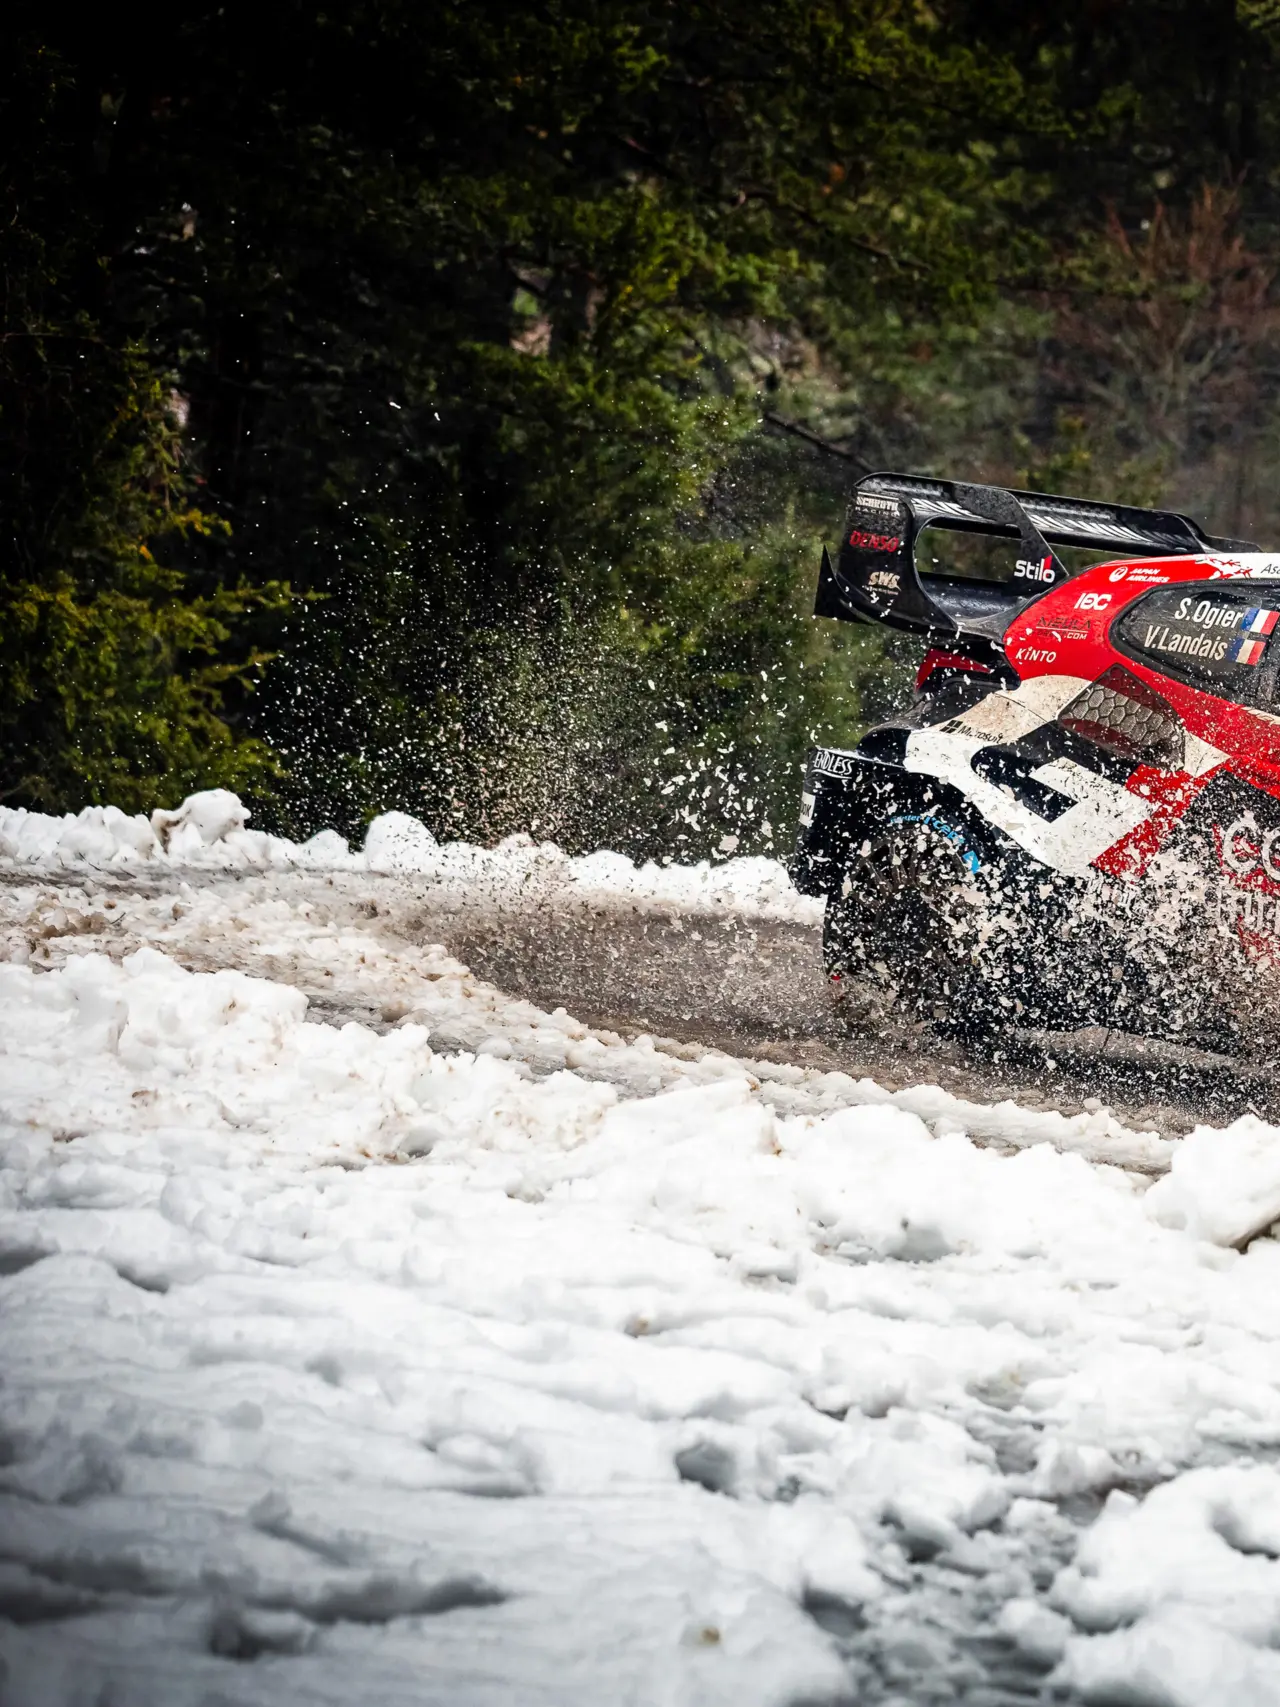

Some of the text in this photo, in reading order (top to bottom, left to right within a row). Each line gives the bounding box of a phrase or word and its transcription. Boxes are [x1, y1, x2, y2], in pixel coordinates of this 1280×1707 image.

[849, 530, 899, 553] DENSO
[868, 571, 901, 591] SWS
[813, 750, 855, 775] ENDLESS
